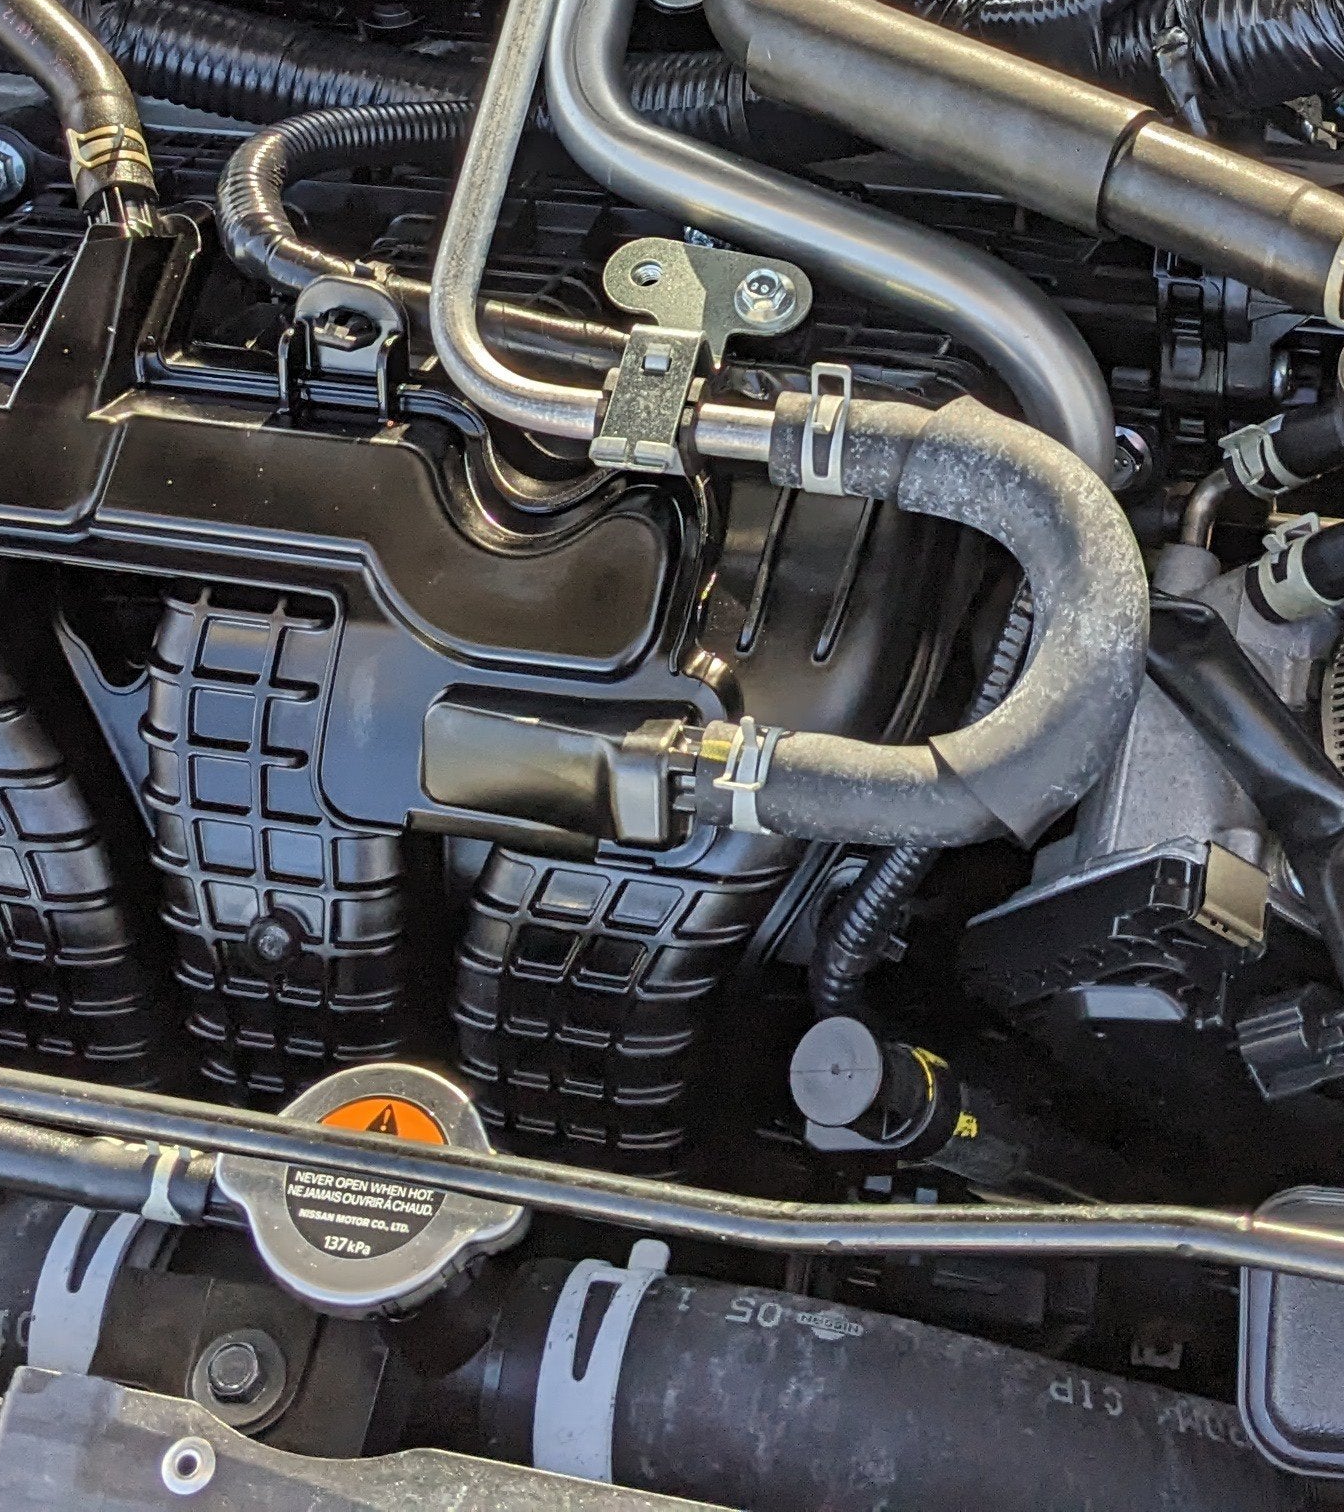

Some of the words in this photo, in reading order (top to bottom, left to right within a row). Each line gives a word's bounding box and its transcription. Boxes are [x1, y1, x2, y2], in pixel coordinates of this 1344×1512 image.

[287, 1184, 304, 1197] NE
[304, 1187, 342, 1203] JAMAIS
[342, 1192, 383, 1209] OUVRIR
[392, 1199, 433, 1216] CHAUD.
[295, 1170, 334, 1186] NEVER
[335, 1176, 368, 1192] OPEN
[370, 1182, 406, 1197] WHEN
[408, 1187, 434, 1202] HOT.
[298, 1208, 335, 1222] NISSAN
[336, 1215, 370, 1228] MOTOR
[390, 1222, 410, 1233] LTD.
[324, 1235, 347, 1251] 137
[347, 1239, 371, 1256] kPa
[724, 1296, 783, 1328] 05
[1049, 1377, 1123, 1416] CIP
